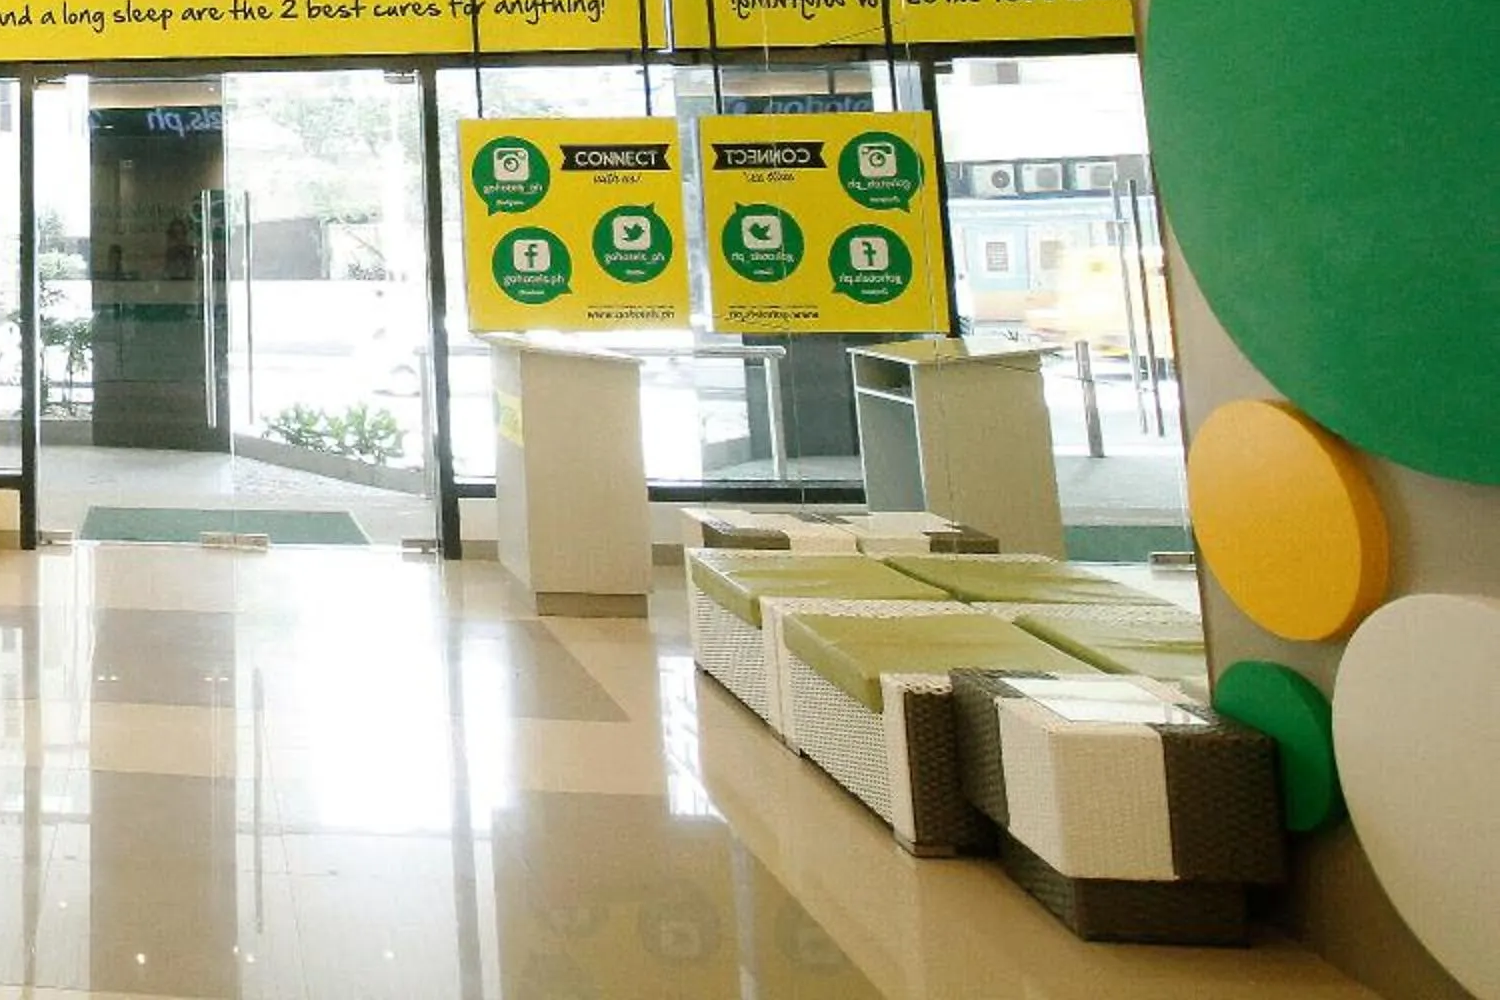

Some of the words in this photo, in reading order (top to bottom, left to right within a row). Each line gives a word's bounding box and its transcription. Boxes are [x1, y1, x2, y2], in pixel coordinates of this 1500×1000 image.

[41, 8, 56, 25] a
[63, 1, 104, 34] long
[113, 0, 173, 30] sleep
[181, 4, 225, 21] are
[374, 0, 441, 17] cures
[575, 151, 658, 166] CONNECT
